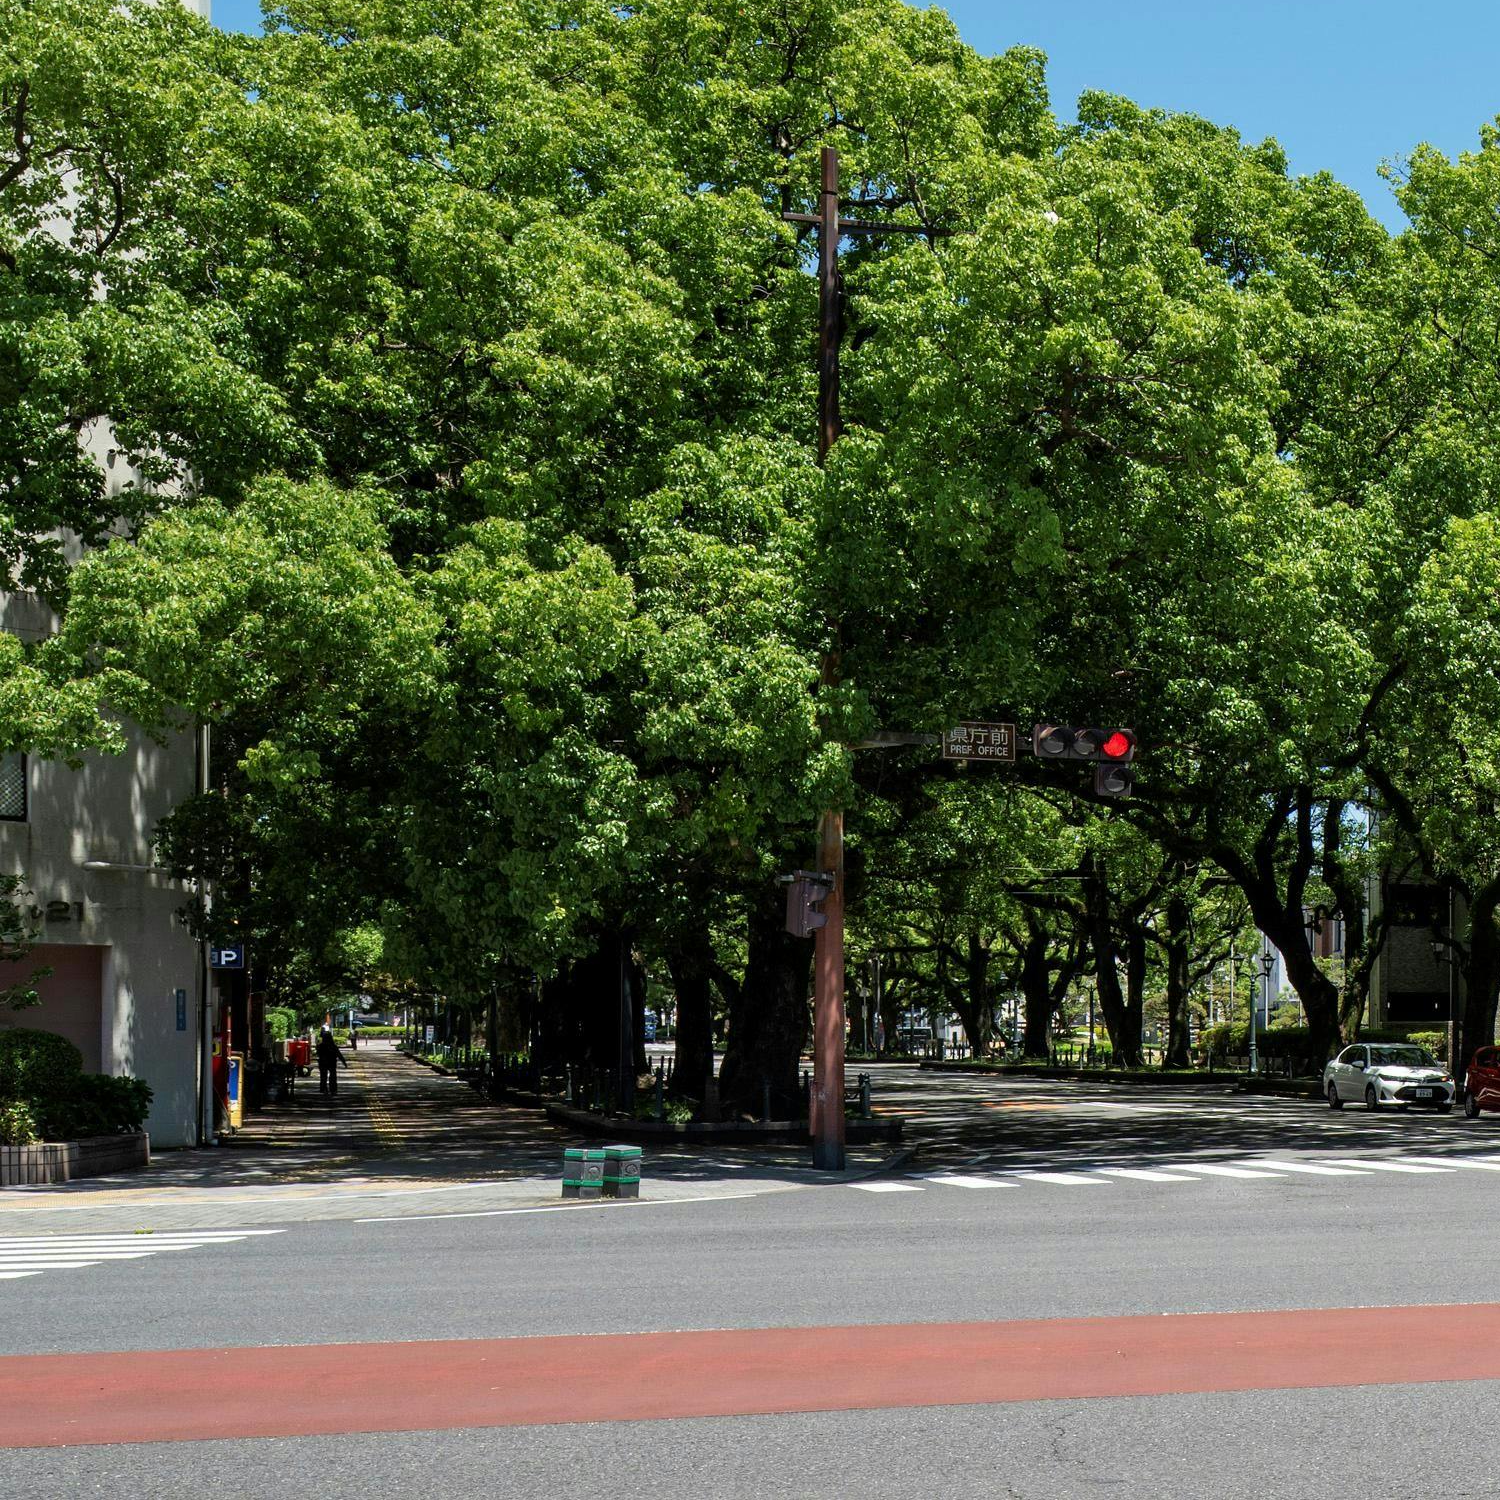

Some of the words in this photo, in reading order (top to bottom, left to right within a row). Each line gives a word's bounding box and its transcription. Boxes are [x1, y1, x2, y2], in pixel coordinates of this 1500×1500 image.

[949, 726, 1009, 745] 県庁前
[950, 745, 975, 755] PREF.
[978, 746, 1009, 756] OFFICE
[220, 950, 237, 965] P
